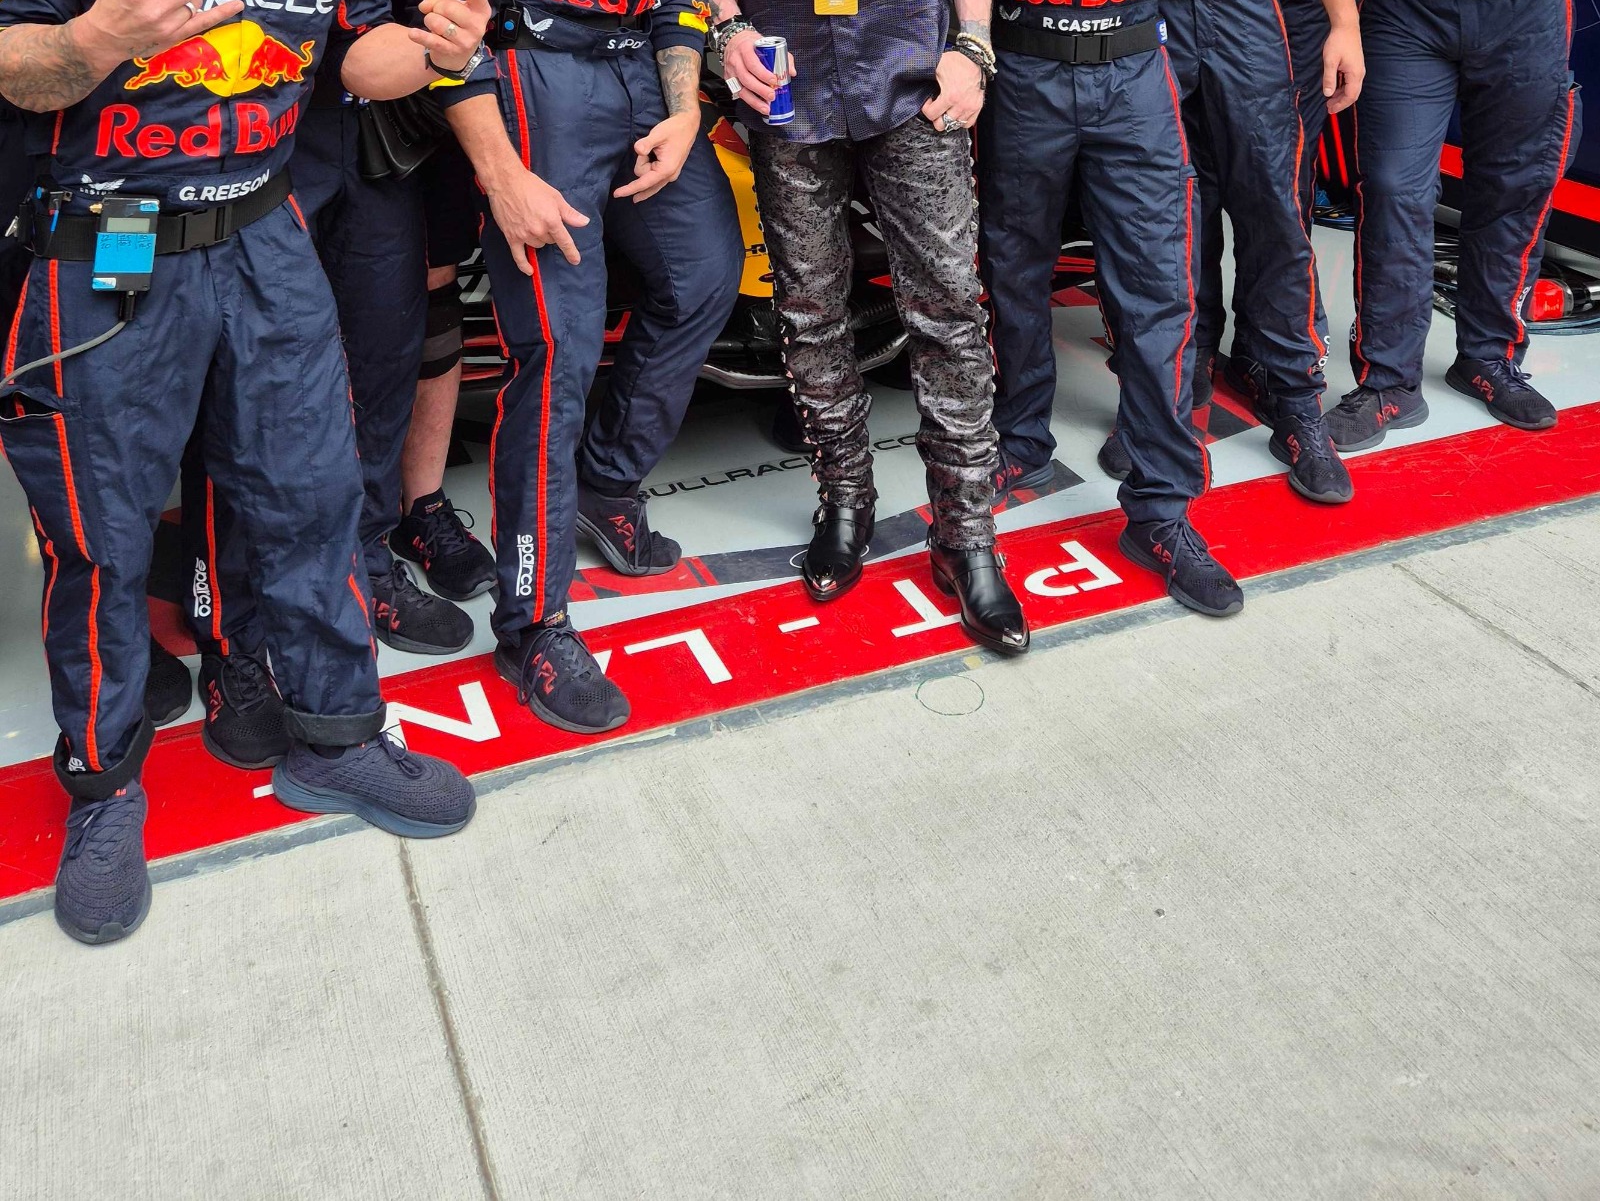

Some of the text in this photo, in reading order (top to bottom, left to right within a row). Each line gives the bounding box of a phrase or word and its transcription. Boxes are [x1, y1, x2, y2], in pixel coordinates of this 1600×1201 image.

[1042, 16, 1122, 32] R. CASTELL
[95, 101, 299, 159] Red Bull
[178, 169, 270, 202] G.REESON
[193, 556, 212, 618] sparco
[516, 535, 535, 596] sparco
